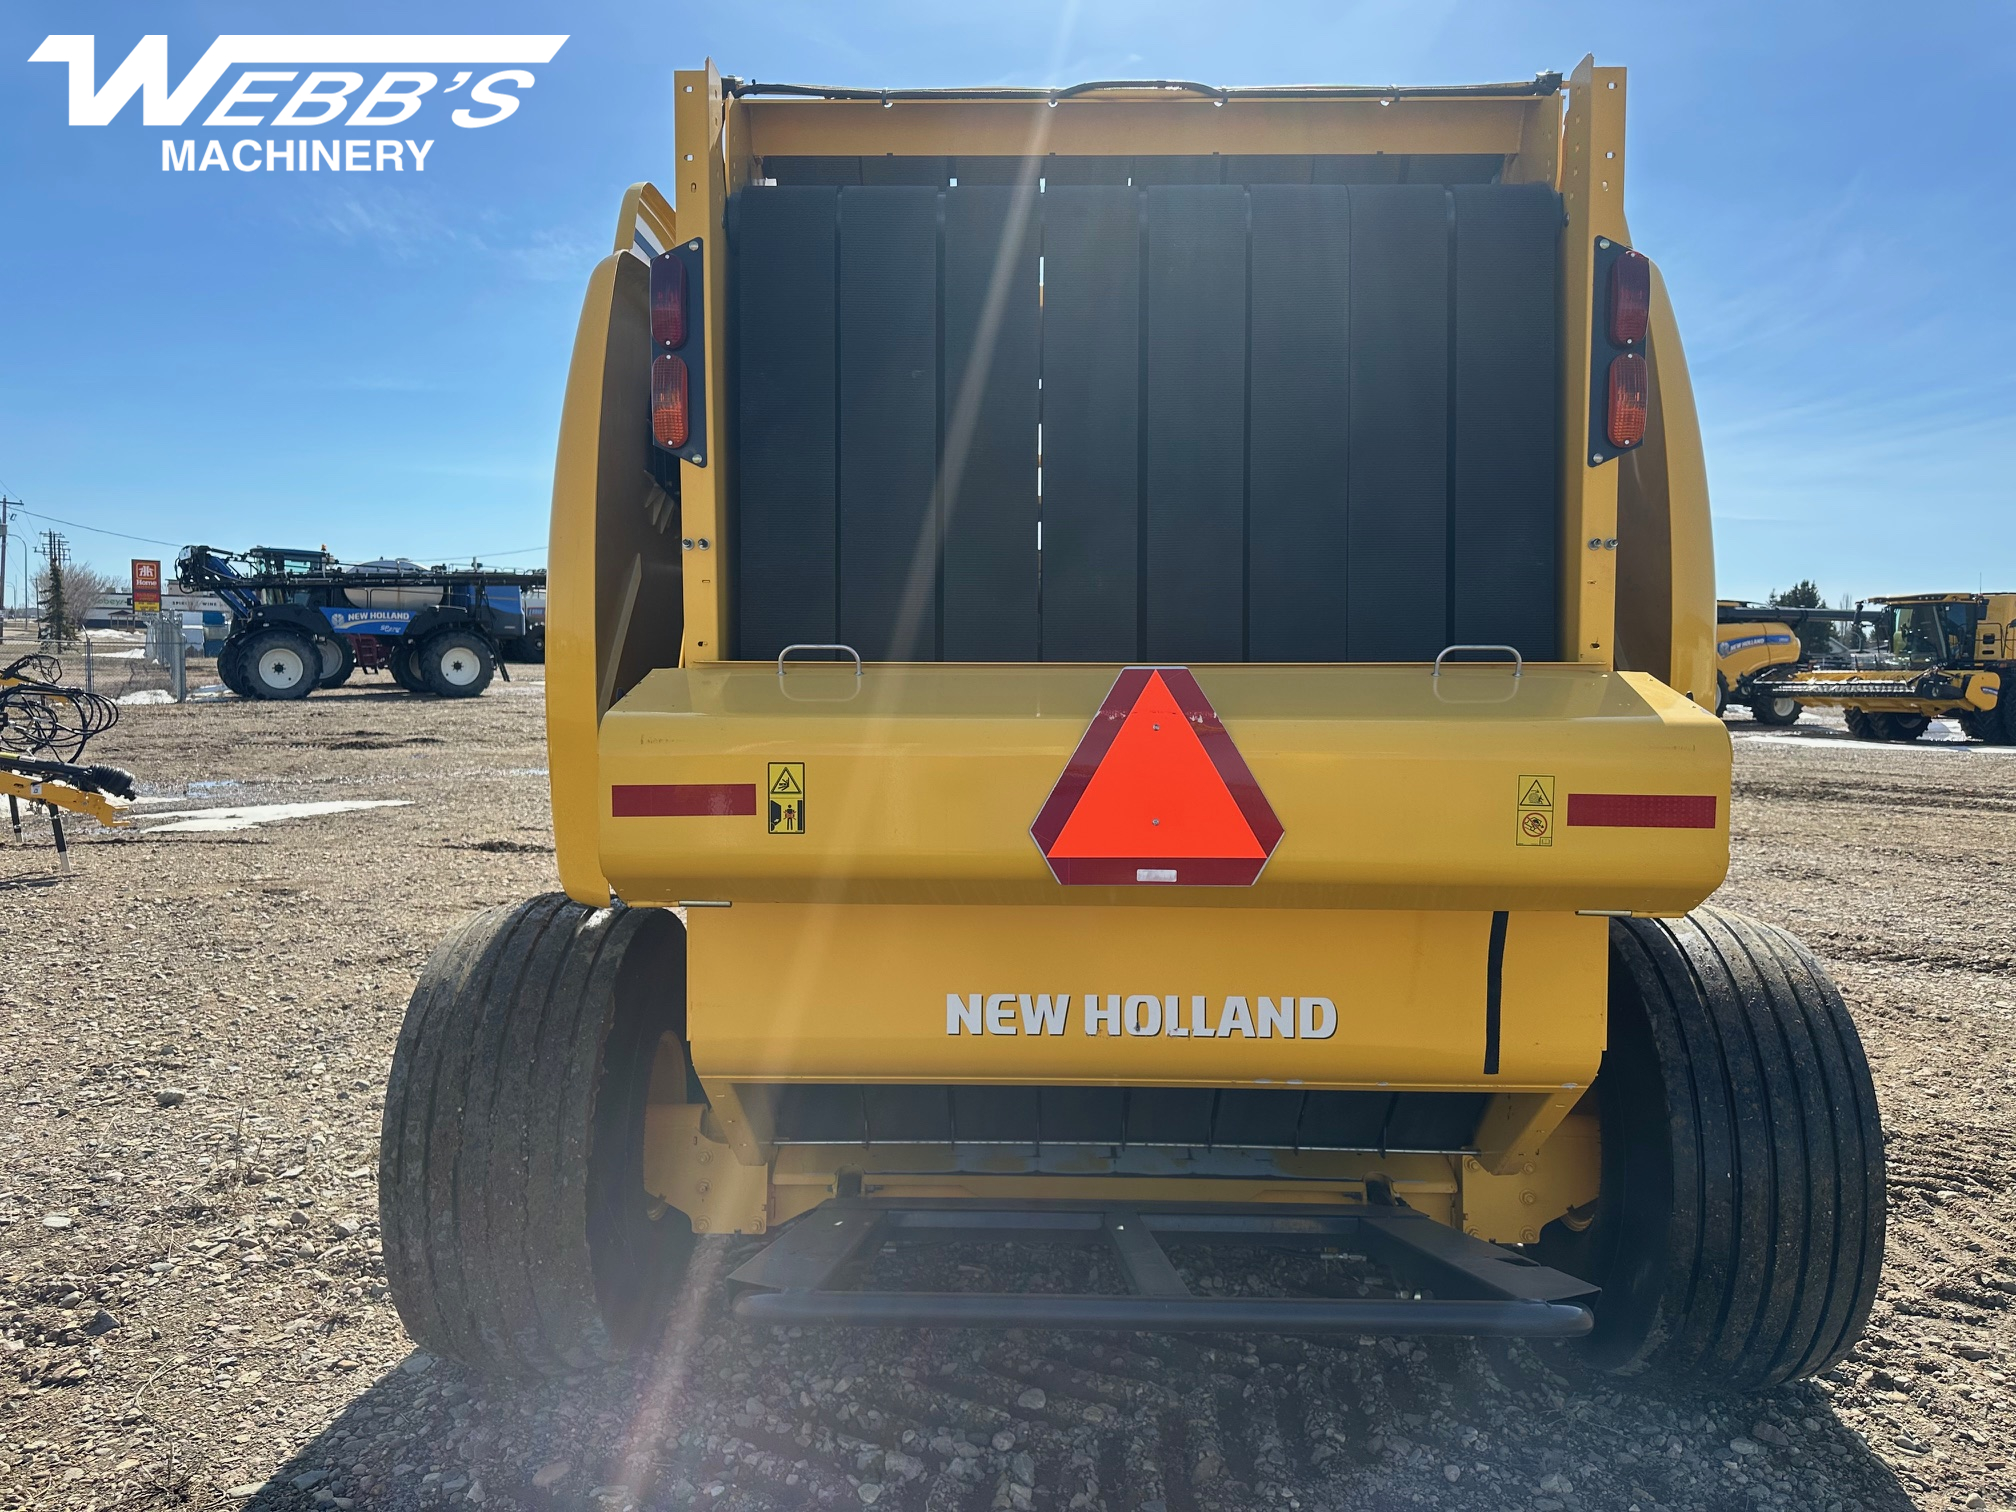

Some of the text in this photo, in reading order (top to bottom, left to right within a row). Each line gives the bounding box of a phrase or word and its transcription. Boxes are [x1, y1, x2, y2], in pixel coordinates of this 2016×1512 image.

[348, 612, 410, 621] NEW HOLLAND
[1730, 638, 1765, 651] NEW HOLLAND
[946, 993, 1338, 1040] NEW HOLLAND
